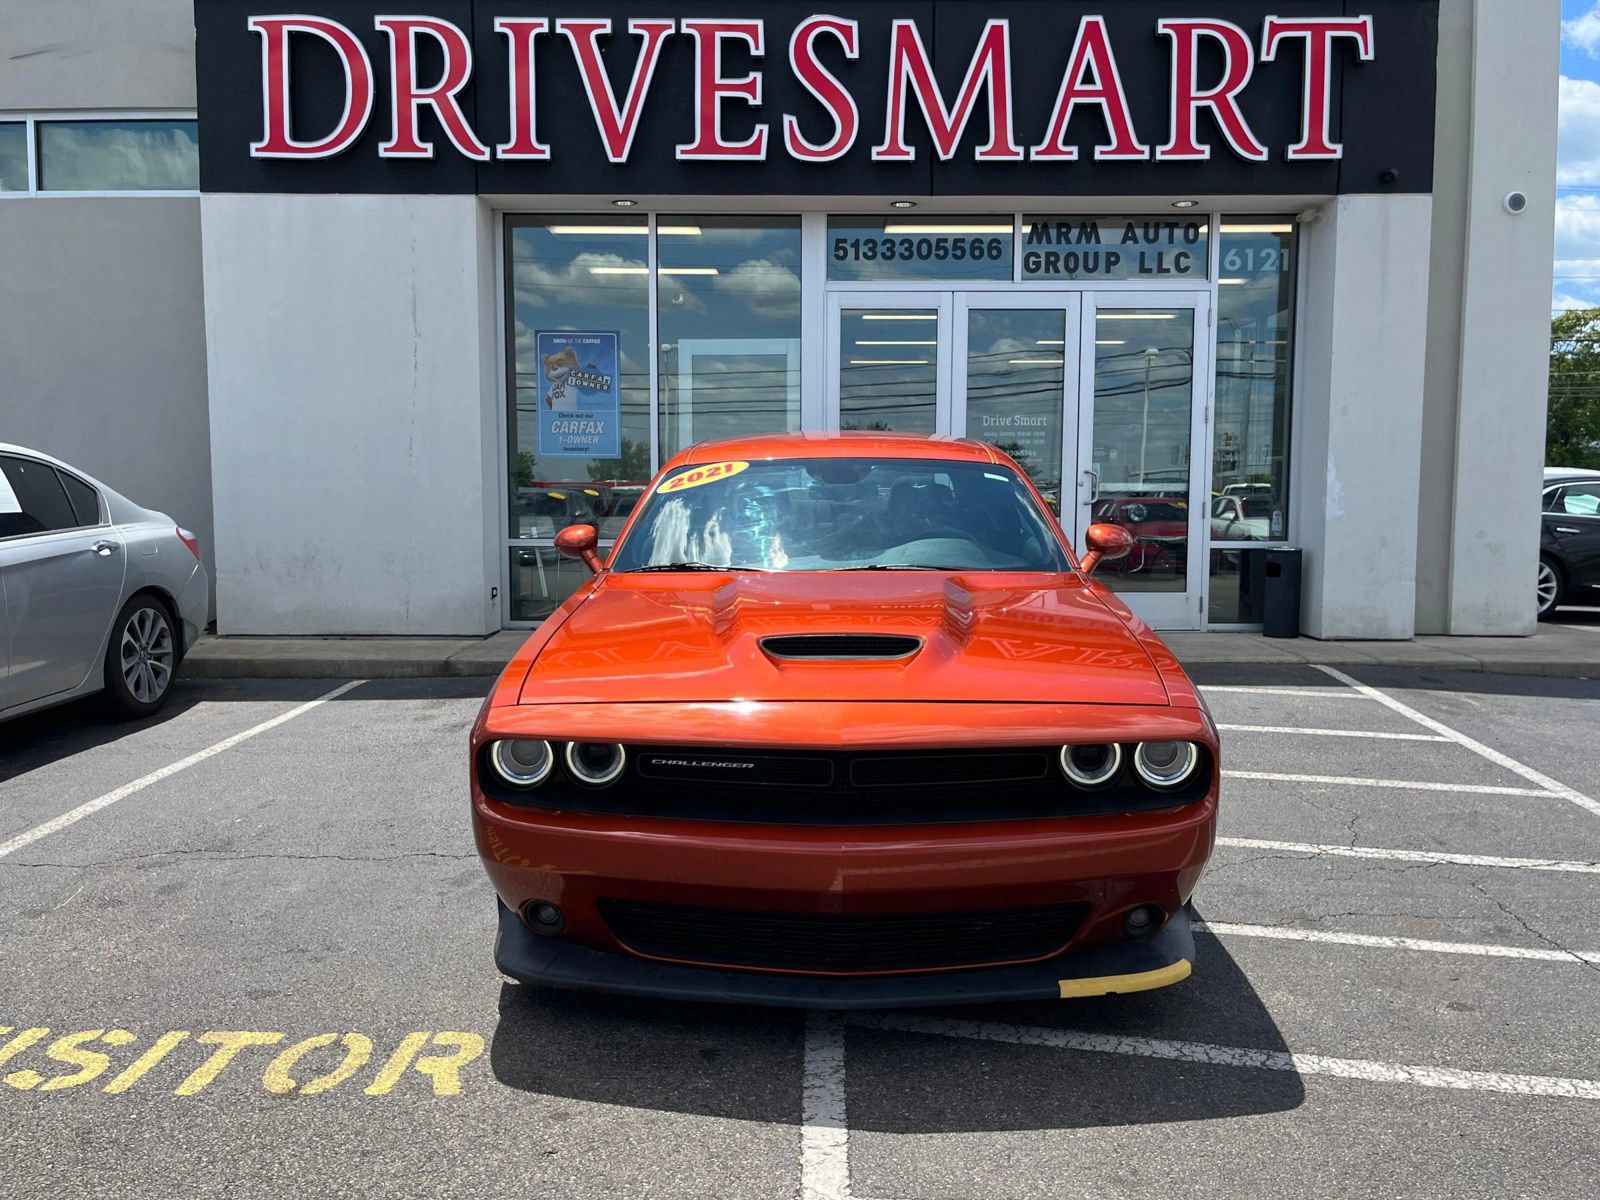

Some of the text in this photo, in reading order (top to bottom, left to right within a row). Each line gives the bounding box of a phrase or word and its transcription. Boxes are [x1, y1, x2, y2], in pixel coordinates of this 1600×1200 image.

[247, 14, 1375, 163] DRIVESMART
[1027, 222, 1200, 245] MRM AUTO
[833, 238, 1002, 261] 5133305566
[1223, 248, 1290, 272] 6121
[1023, 251, 1191, 274] GROUP LLC
[576, 379, 609, 392] OWNER
[551, 420, 605, 434] CARFAX
[983, 415, 1048, 426] Drive Smart
[558, 435, 600, 444] 1-OWNER
[669, 463, 733, 490] 2021
[651, 759, 754, 769] CHALLENGER
[0, 1026, 486, 1097] ISITOR
